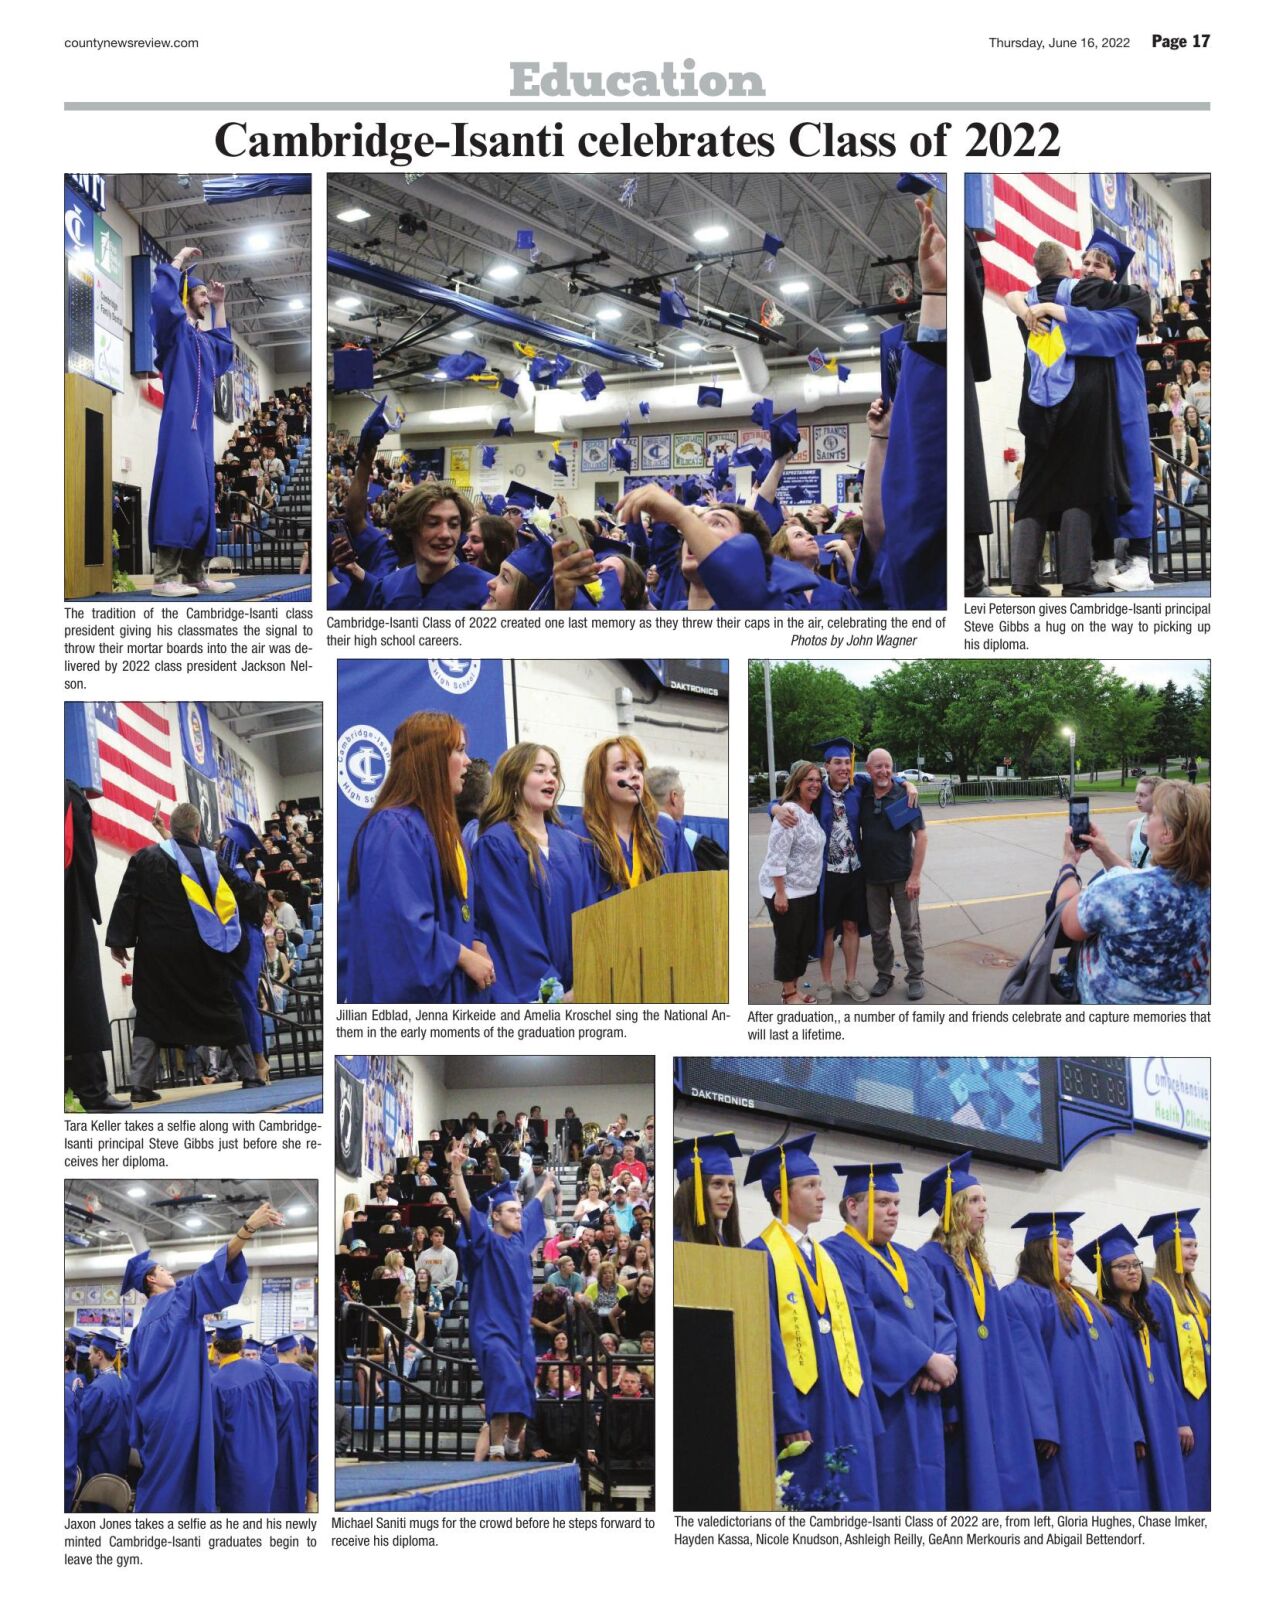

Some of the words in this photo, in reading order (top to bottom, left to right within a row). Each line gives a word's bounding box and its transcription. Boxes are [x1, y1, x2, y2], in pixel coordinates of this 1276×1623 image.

[65, 38, 198, 50] countynewsreview.com
[989, 38, 1044, 50] Thursday,
[1049, 38, 1077, 48] June
[1081, 38, 1098, 49] 16,
[1102, 38, 1130, 48] 2022
[1152, 34, 1187, 50] Page
[1193, 34, 1211, 47] 17
[510, 58, 765, 96] Education
[215, 122, 564, 167] Cambridge-Isanti
[578, 123, 775, 157] celebrates
[790, 122, 896, 157] Class
[910, 122, 952, 157] of
[965, 122, 1061, 157] 2022
[816, 448, 846, 460] SAINTS
[64, 607, 84, 619] The
[92, 608, 135, 619] tradition
[144, 607, 154, 619] of
[161, 608, 178, 619] the
[186, 607, 278, 621] Cambridge-Isanti
[286, 608, 313, 619] class
[965, 603, 986, 614] Levi
[989, 603, 1035, 614] Peterson
[1039, 603, 1067, 617] gives
[1070, 603, 1161, 617] Cambridge-Isanti
[1165, 603, 1210, 616] principal
[327, 617, 418, 631] Cambridge-Isanti
[423, 617, 451, 628] Class
[455, 617, 465, 628] of
[469, 617, 496, 628] 2022
[501, 617, 541, 628] created
[545, 619, 564, 628] one
[569, 617, 588, 628] last
[592, 619, 635, 630] memory
[639, 619, 652, 628] as
[655, 617, 678, 630] they
[682, 617, 713, 628] threw
[716, 617, 741, 628] their
[745, 619, 770, 630] caps
[774, 617, 783, 628] in
[787, 617, 804, 628] the
[808, 617, 823, 629] air,
[827, 617, 887, 631] celebrating
[891, 617, 908, 628] the
[912, 617, 931, 628] end
[935, 617, 946, 628] of
[65, 625, 114, 638] president
[120, 625, 151, 638] giving
[157, 625, 173, 636] his
[178, 625, 238, 636] classmates
[243, 625, 260, 636] the
[266, 625, 297, 639] signal
[303, 625, 313, 636] to
[791, 635, 827, 646] Photos
[831, 635, 844, 648] by
[846, 635, 873, 646] John
[877, 635, 918, 648] Wagner
[670, 681, 719, 696] DAKTRONICS
[336, 1009, 367, 1021] Jillian
[372, 1009, 411, 1022] Edblad,
[416, 1010, 448, 1021] Jenna
[453, 1009, 496, 1021] Kirkeide
[501, 1010, 520, 1021] and
[524, 1009, 560, 1021] Amelia
[566, 1009, 611, 1021] Kroschel
[616, 1010, 638, 1023] sing
[643, 1009, 659, 1021] the
[664, 1009, 707, 1021] National
[712, 1009, 730, 1020] An-
[747, 1011, 773, 1022] After
[777, 1011, 840, 1025] graduation,,
[844, 1014, 850, 1022] a
[854, 1011, 895, 1022] number
[899, 1011, 909, 1022] of
[912, 1011, 945, 1024] family
[949, 1011, 968, 1022] and
[972, 1011, 1008, 1022] friends
[1012, 1011, 1061, 1022] celebrate
[1065, 1011, 1085, 1022] and
[1089, 1011, 1129, 1024] capture
[1134, 1011, 1186, 1022] memories
[1189, 1011, 1211, 1022] that
[691, 1087, 755, 1109] DAKTRONICS
[64, 1120, 88, 1131] Tara
[91, 1120, 121, 1131] Keller
[124, 1120, 154, 1131] takes
[157, 1122, 164, 1131] a
[167, 1120, 196, 1131] selfie
[199, 1120, 228, 1134] along
[232, 1120, 255, 1131] with
[259, 1120, 322, 1134] Cambridge-
[64, 1518, 95, 1529] Jaxon
[100, 1518, 131, 1529] Jones
[135, 1518, 164, 1529] takes
[168, 1521, 174, 1529] a
[178, 1518, 206, 1529] selfie
[210, 1521, 222, 1529] as
[226, 1518, 239, 1529] he
[243, 1518, 262, 1529] and
[267, 1518, 282, 1529] his
[286, 1518, 317, 1531] newly
[332, 1517, 373, 1528] Michael
[376, 1517, 406, 1528] Saniti
[410, 1520, 439, 1531] mugs
[442, 1517, 457, 1528] for
[459, 1517, 476, 1528] the
[480, 1517, 512, 1528] crowd
[516, 1517, 549, 1528] before
[553, 1517, 565, 1528] he
[569, 1518, 597, 1531] steps
[600, 1517, 641, 1528] forward
[644, 1518, 655, 1528] to
[675, 1533, 714, 1547] Hayden
[718, 1533, 752, 1546] Kassa,
[756, 1533, 789, 1545] Nicole
[793, 1533, 842, 1547] Knudson,
[844, 1533, 890, 1547] Ashleigh
[894, 1533, 925, 1547] Reilly,
[929, 1533, 963, 1545] GeAnn
[967, 1533, 1020, 1545] Merkouris
[1024, 1534, 1043, 1545] and
[1046, 1533, 1082, 1547] Abigail
[1086, 1533, 1144, 1545] Bettendorf.
